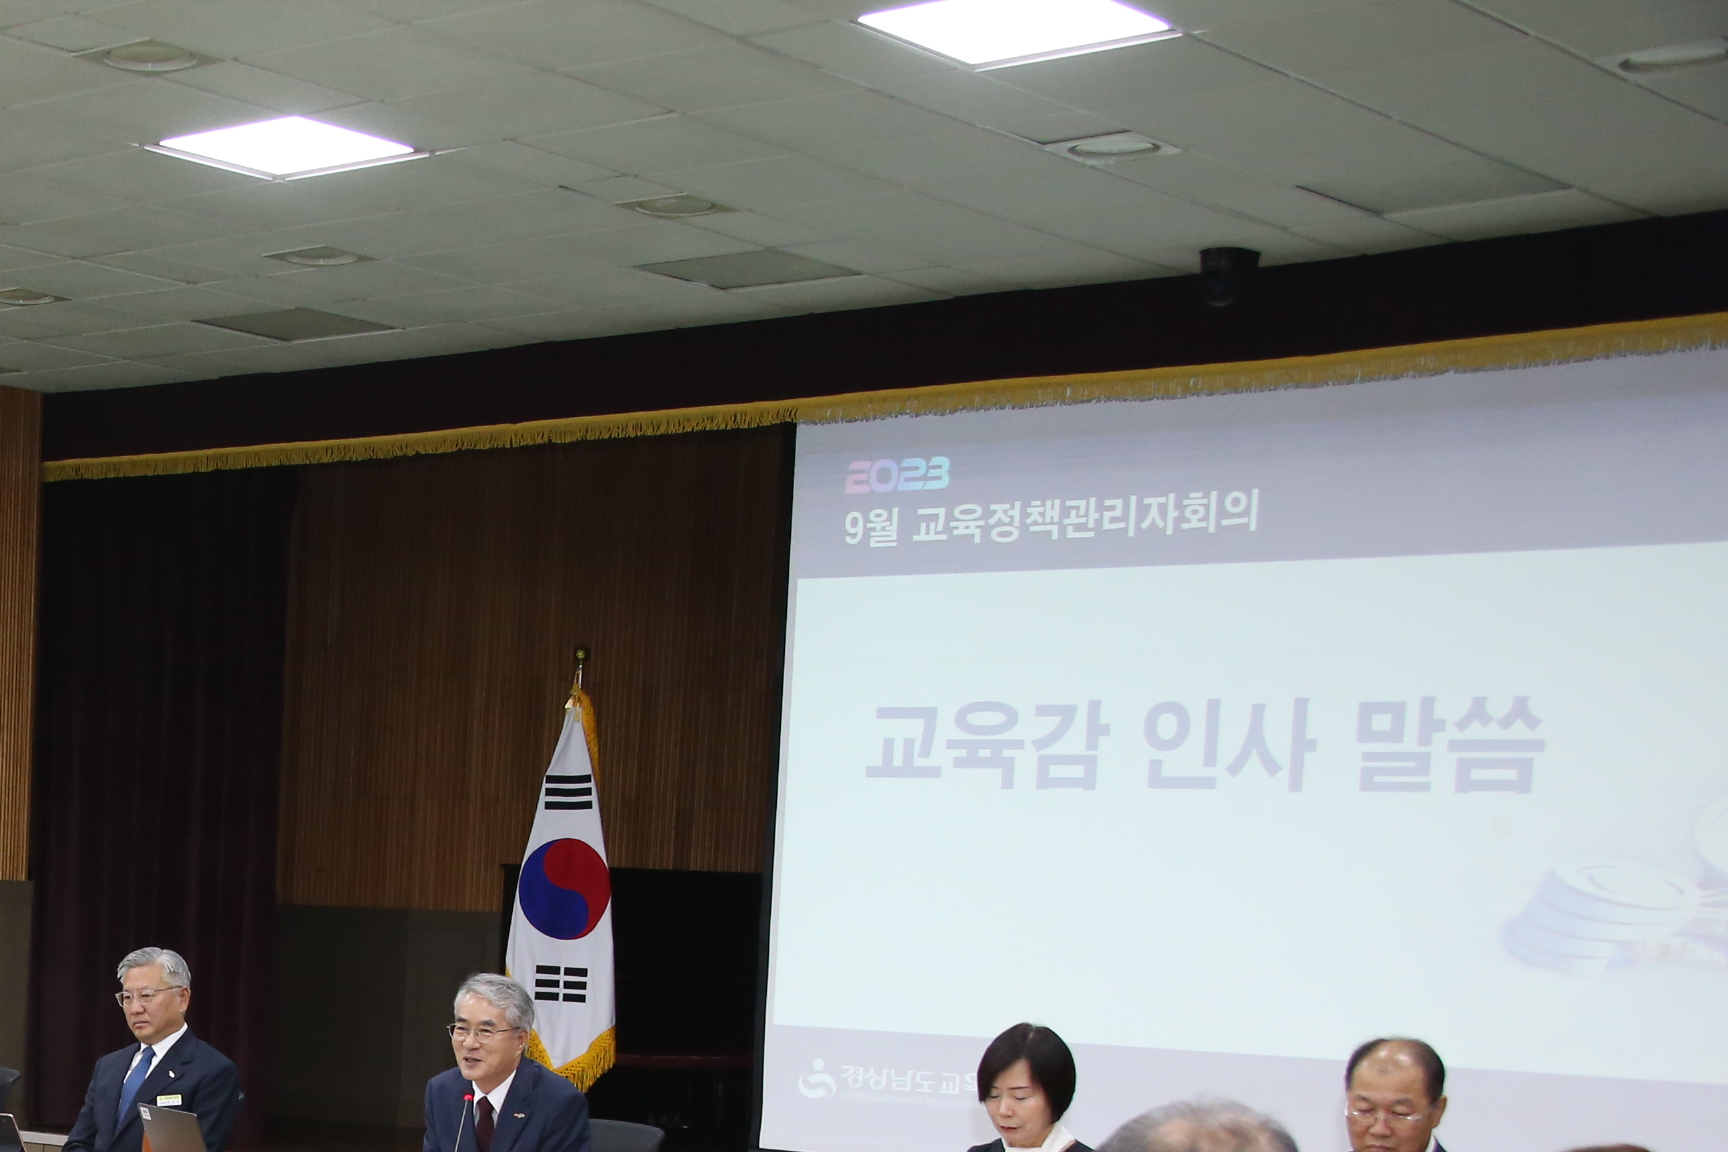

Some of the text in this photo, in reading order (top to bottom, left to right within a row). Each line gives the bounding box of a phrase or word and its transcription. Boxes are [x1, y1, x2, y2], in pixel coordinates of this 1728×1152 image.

[845, 456, 951, 495] 2023
[844, 487, 1260, 549] 9월 교육정책관리자회의
[865, 695, 1546, 795] 교육감 인사 말씀
